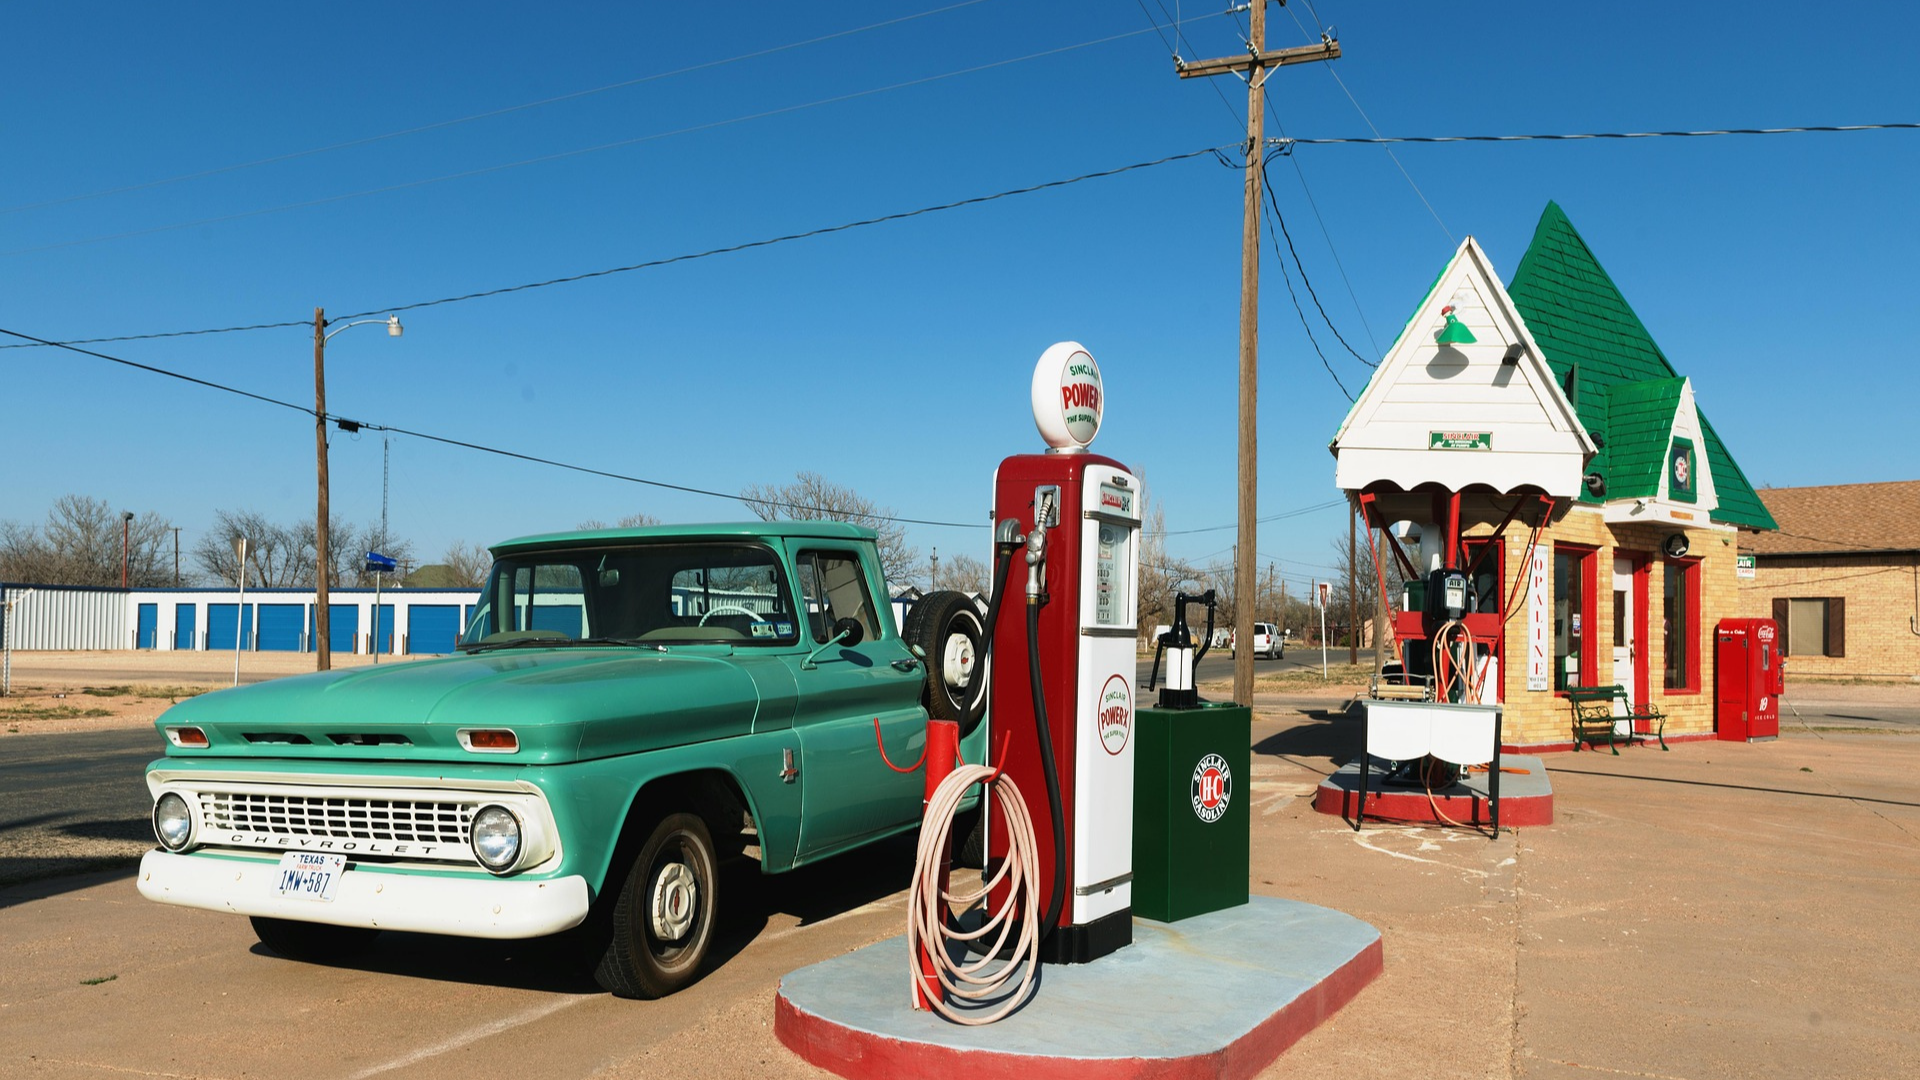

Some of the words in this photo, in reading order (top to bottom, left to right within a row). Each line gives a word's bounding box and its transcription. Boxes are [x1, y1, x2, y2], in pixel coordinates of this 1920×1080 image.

[1106, 691, 1126, 703] SINCLAIR
[1194, 756, 1229, 783] SINCLAIR
[1193, 792, 1229, 820] GASOLINE
[231, 834, 437, 854] CHEVROLET
[299, 854, 325, 865] TEXAS
